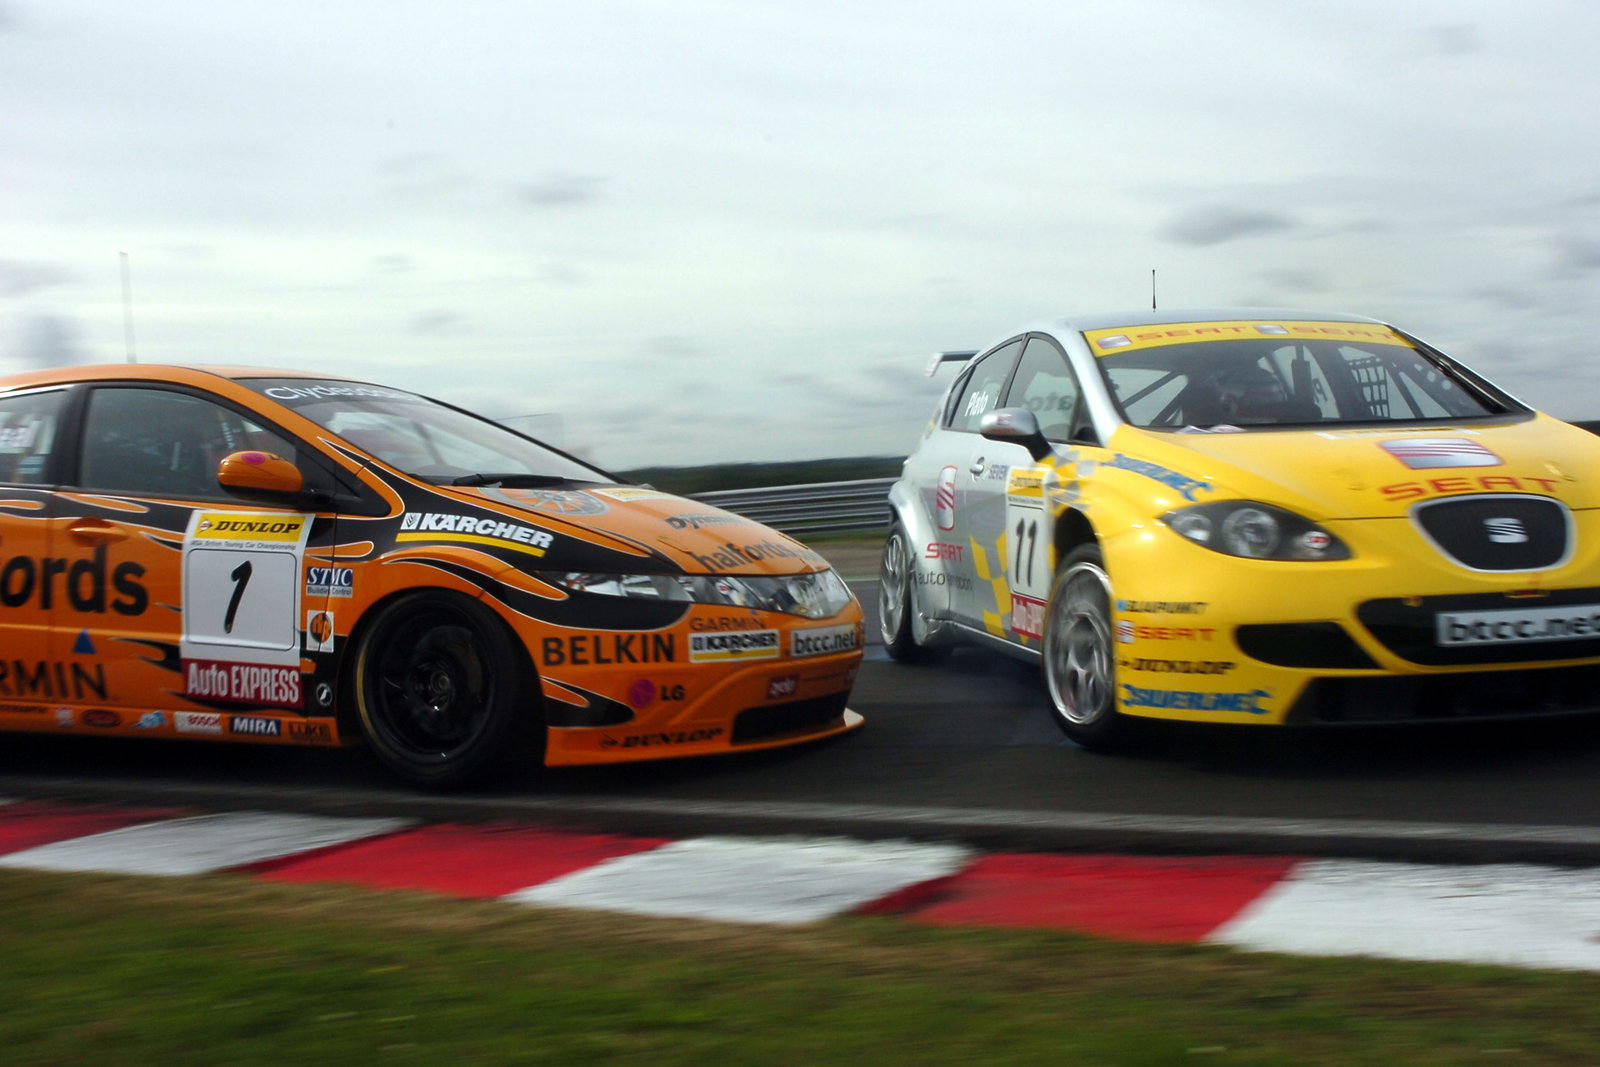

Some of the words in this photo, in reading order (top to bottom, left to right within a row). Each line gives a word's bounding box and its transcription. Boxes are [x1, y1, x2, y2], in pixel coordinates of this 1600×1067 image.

[1136, 326, 1247, 341] SEAT
[1292, 326, 1395, 341] SEAT
[1379, 475, 1559, 502] SEAT
[213, 520, 300, 534] DUNLOP
[420, 511, 554, 550] KÄRCHER
[245, 541, 256, 549] Car
[257, 542, 296, 551] Championship
[924, 542, 964, 563] SEAT
[1015, 517, 1037, 588] 11
[307, 566, 354, 587] STMC
[917, 571, 946, 585] auto
[224, 559, 253, 635] 1
[690, 616, 767, 632] GARMIN
[1137, 626, 1217, 641] SEAT
[1451, 612, 1600, 642] btcc.net
[543, 633, 676, 666] BELKIN
[794, 629, 856, 655] btcc.net
[187, 661, 229, 697] Auto
[231, 666, 300, 703] EXPRESS
[660, 685, 686, 701] LG
[233, 716, 279, 735] MIRA
